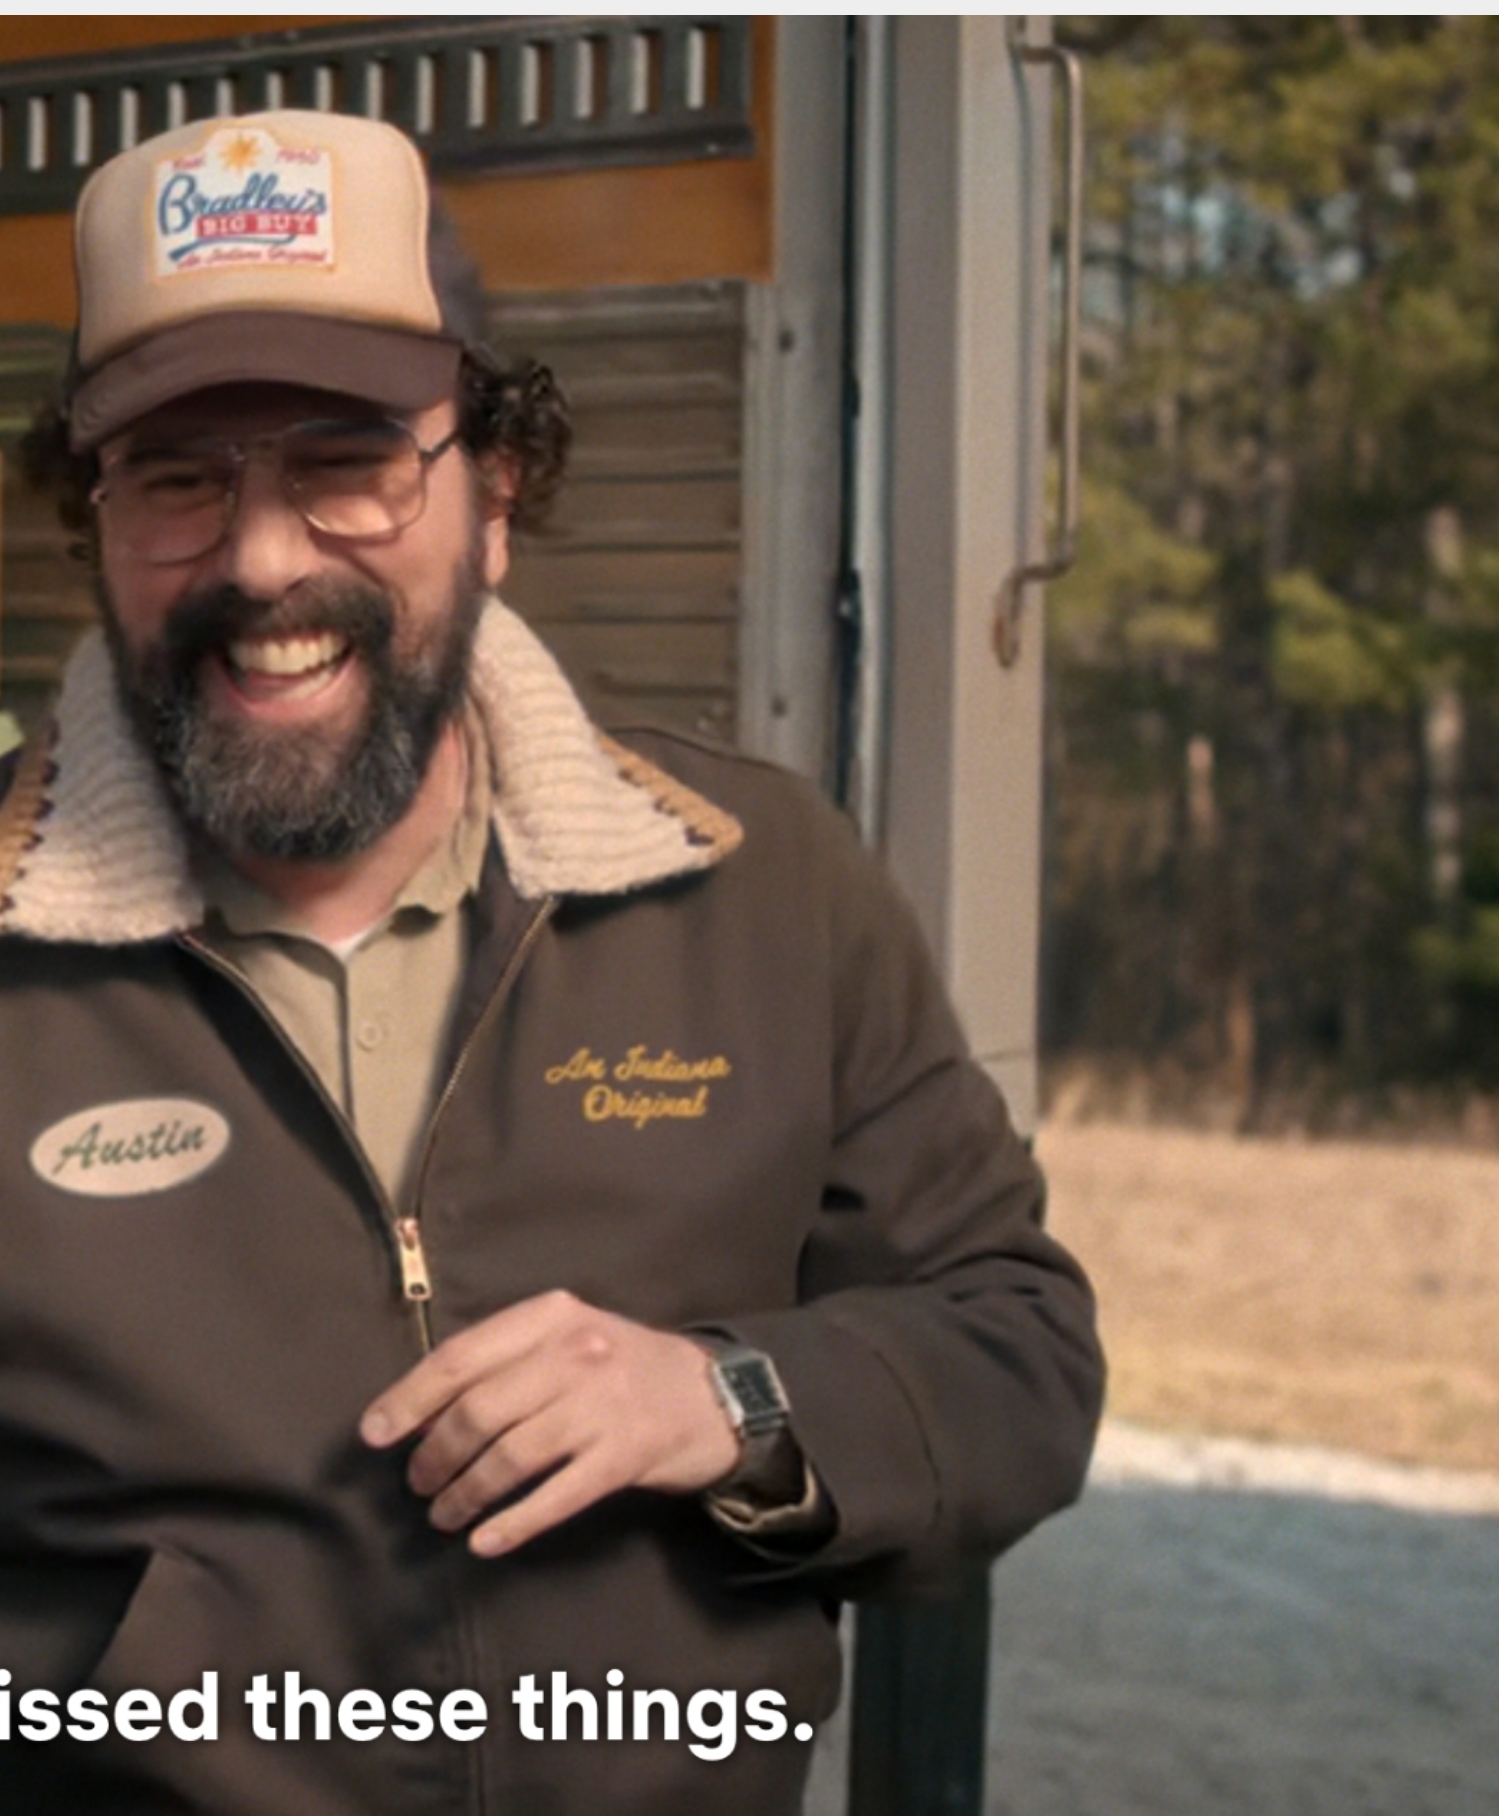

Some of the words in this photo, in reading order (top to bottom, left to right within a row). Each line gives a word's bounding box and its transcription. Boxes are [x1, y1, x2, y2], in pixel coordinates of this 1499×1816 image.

[158, 172, 328, 236] Bradley's
[203, 215, 246, 235] BIG
[544, 1046, 606, 1084] An
[613, 1044, 732, 1081] Indiana
[583, 1083, 709, 1130] Original
[52, 1120, 206, 1176] Austin
